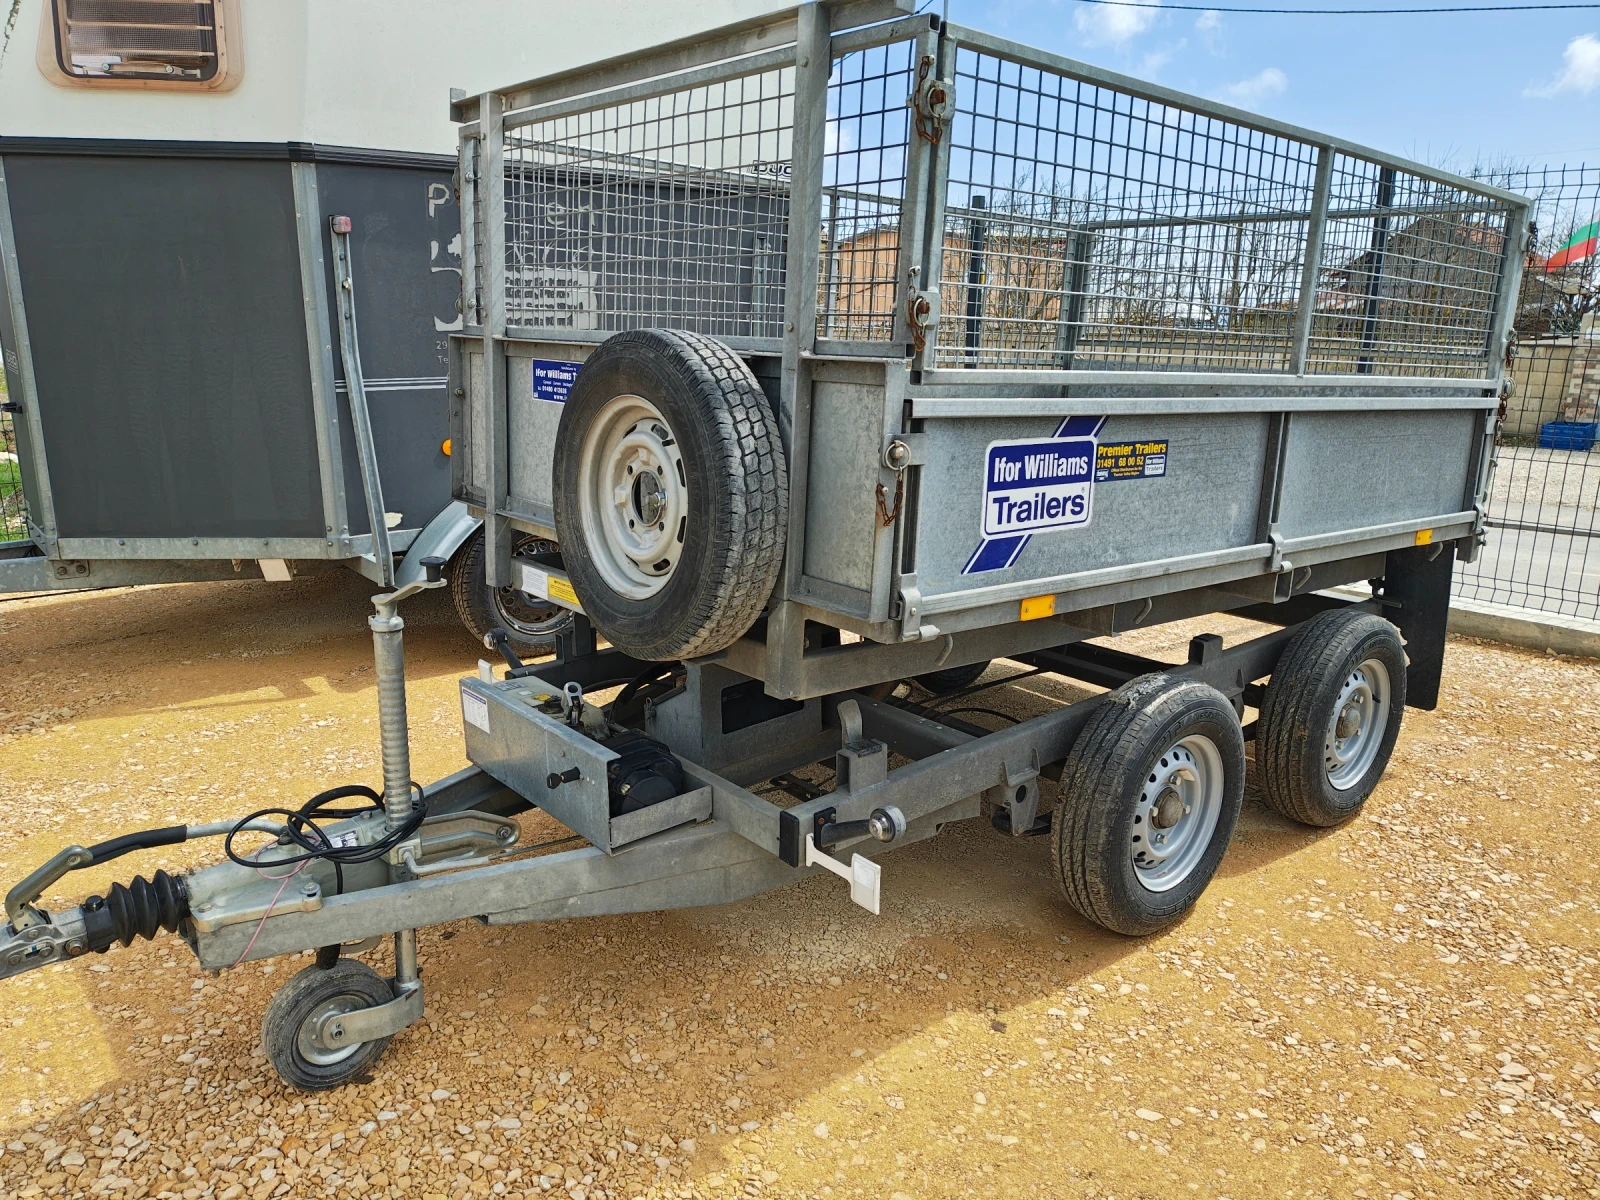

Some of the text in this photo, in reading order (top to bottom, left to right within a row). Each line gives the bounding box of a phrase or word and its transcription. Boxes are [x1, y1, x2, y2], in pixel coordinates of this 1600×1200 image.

[535, 368, 547, 378] Ifor
[547, 369, 572, 381] Williams
[1097, 442, 1167, 457] Premier Trailers
[993, 456, 1022, 483] Ifor
[1024, 453, 1088, 480] Williams
[1127, 456, 1136, 466] 00
[992, 492, 1085, 525] Trailers
